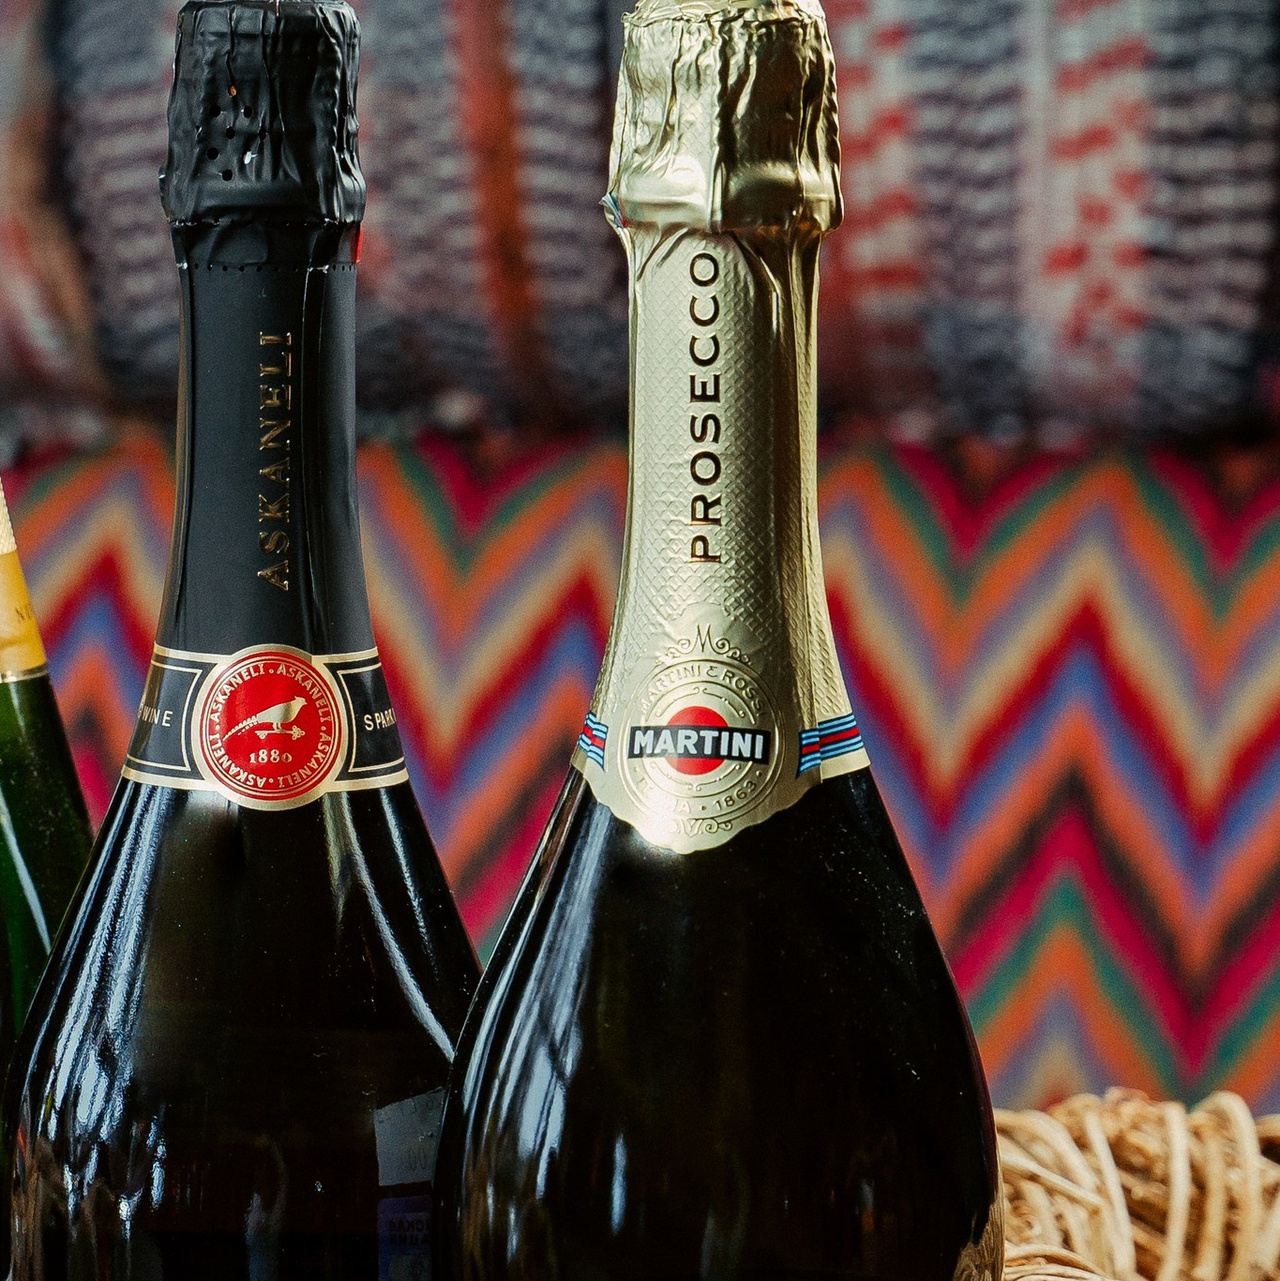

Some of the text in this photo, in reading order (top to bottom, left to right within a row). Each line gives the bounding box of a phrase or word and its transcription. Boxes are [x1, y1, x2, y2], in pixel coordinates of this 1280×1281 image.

[689, 250, 721, 564] PROSECCO
[258, 331, 293, 592] ASKANELI
[639, 665, 701, 714] MARTINI
[721, 668, 768, 717] ROSSI
[209, 663, 332, 788] ASKANELI ASKANELI ASKANELI ASKANELI
[633, 729, 764, 760] MARTINI
[249, 749, 292, 764] 1880
[713, 780, 757, 811] 1863
